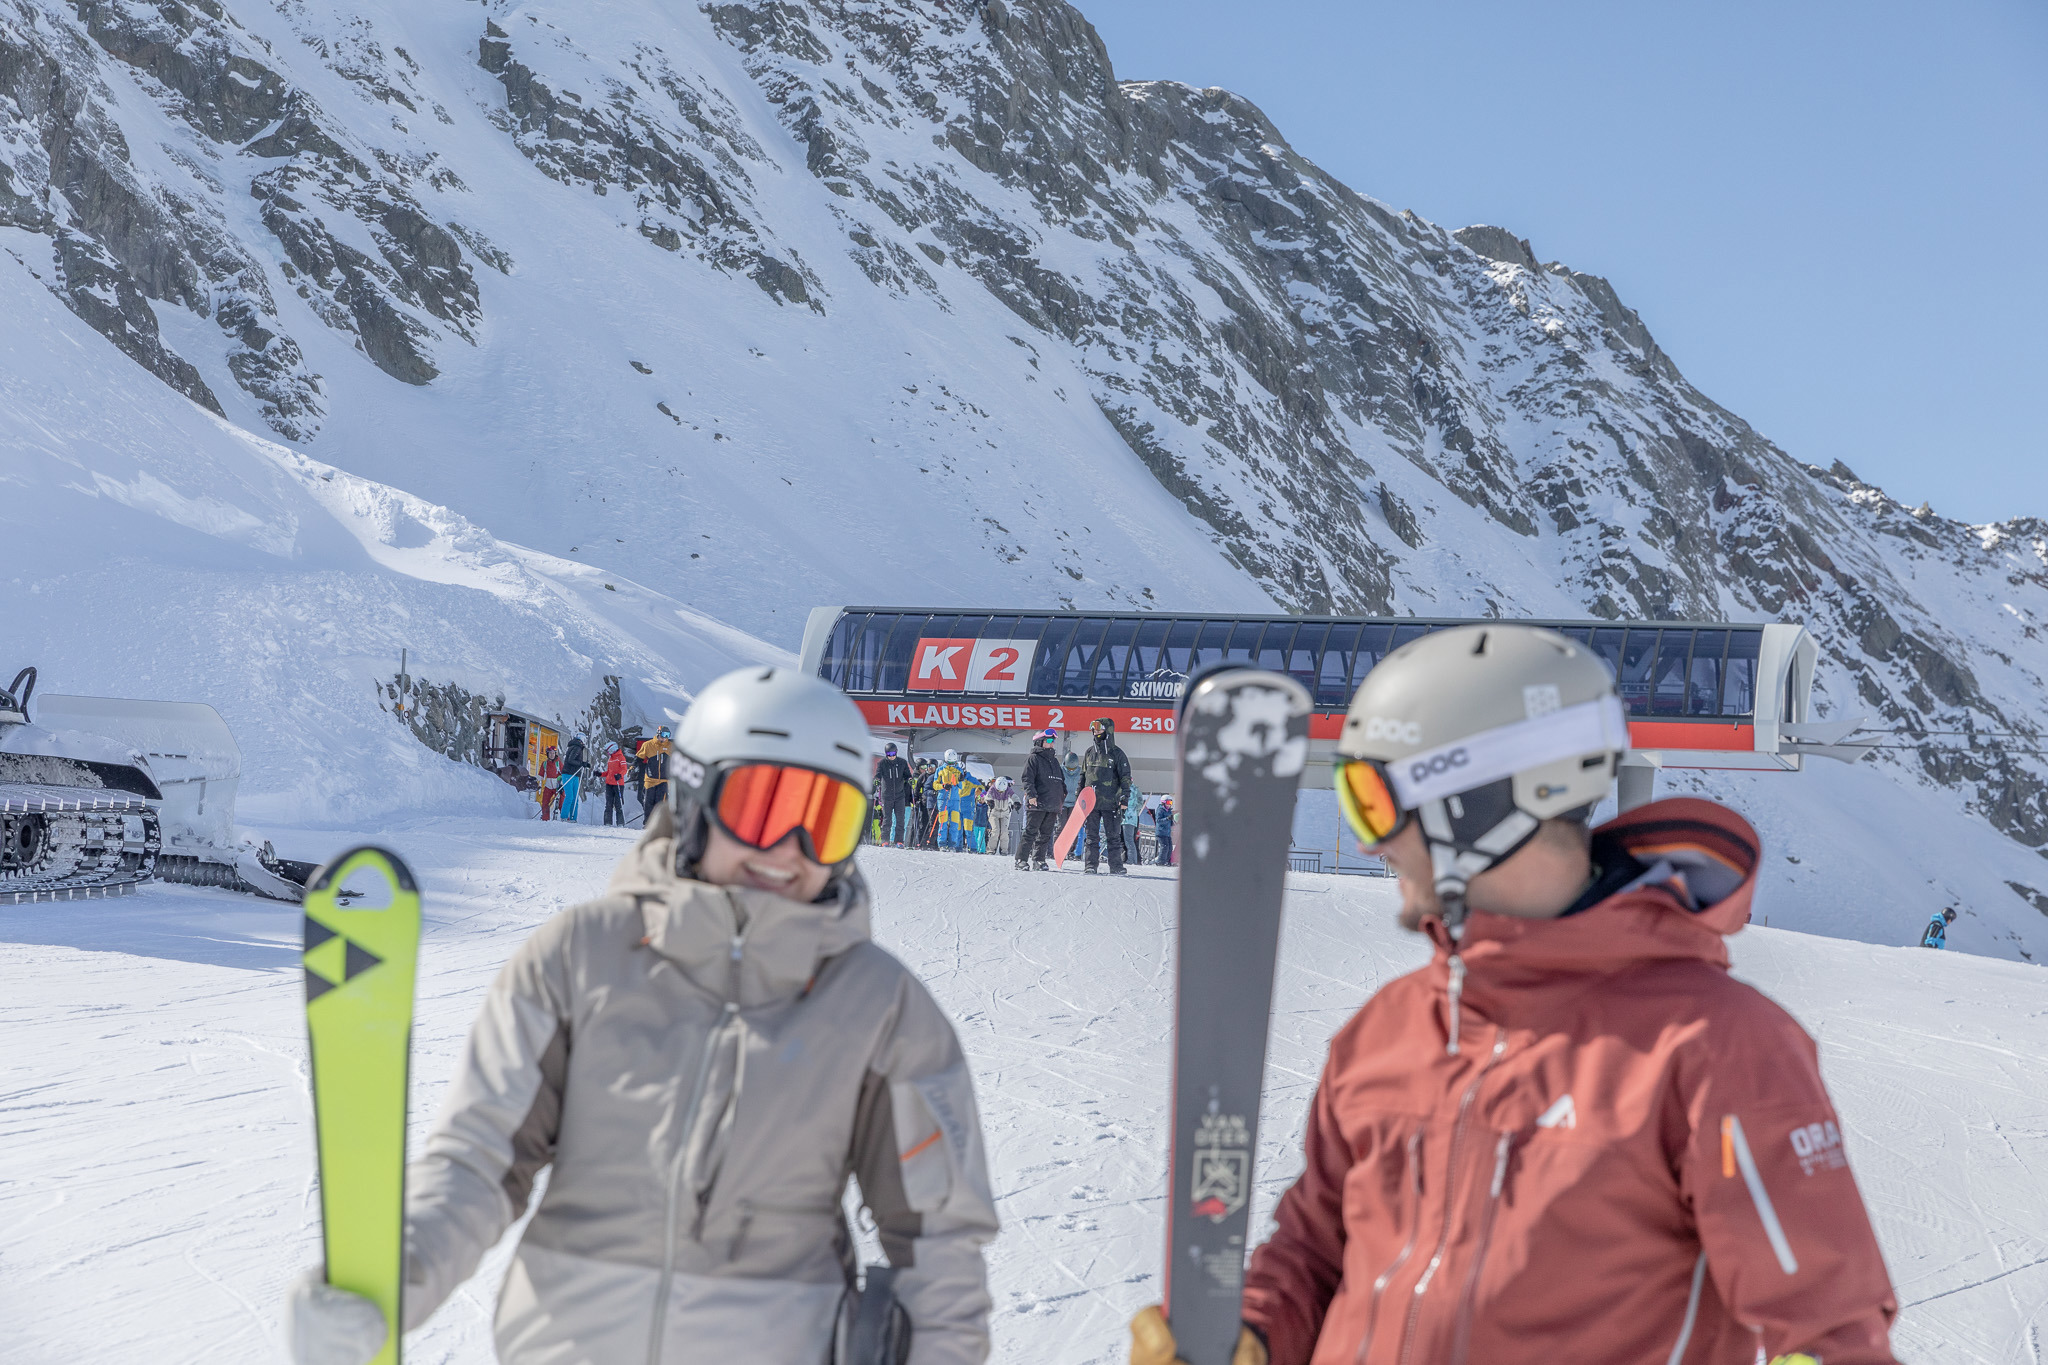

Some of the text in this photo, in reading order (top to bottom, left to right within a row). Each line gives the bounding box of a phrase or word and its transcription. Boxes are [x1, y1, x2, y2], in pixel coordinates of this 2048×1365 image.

[918, 646, 1020, 681] K 2
[1130, 681, 1184, 698] SKIWOR
[888, 704, 1175, 732] KLAUSSEE 2 2510
[1410, 747, 1470, 783] POC
